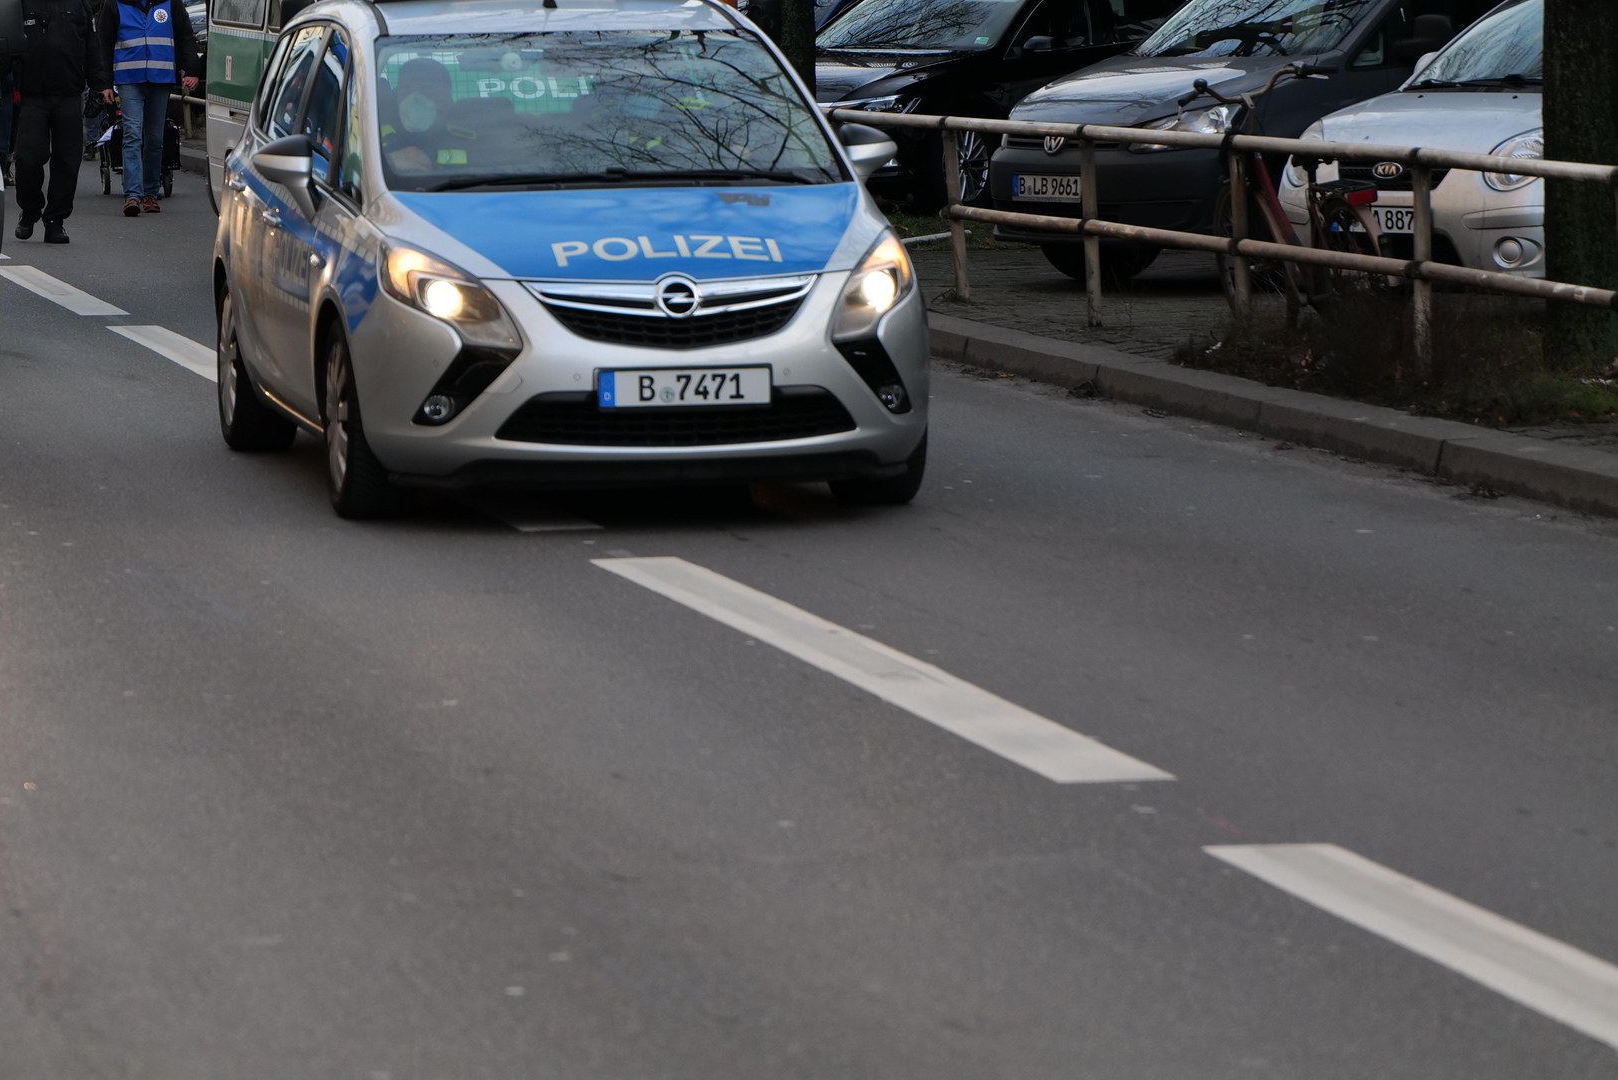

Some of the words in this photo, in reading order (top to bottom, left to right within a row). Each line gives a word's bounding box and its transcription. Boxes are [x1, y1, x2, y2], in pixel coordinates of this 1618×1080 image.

[476, 75, 593, 99] POLI
[1376, 165, 1397, 175] KIA
[1051, 178, 1079, 196] 9661
[551, 234, 783, 267] POLIZEI
[638, 375, 656, 401] B
[676, 373, 745, 401] 7471
